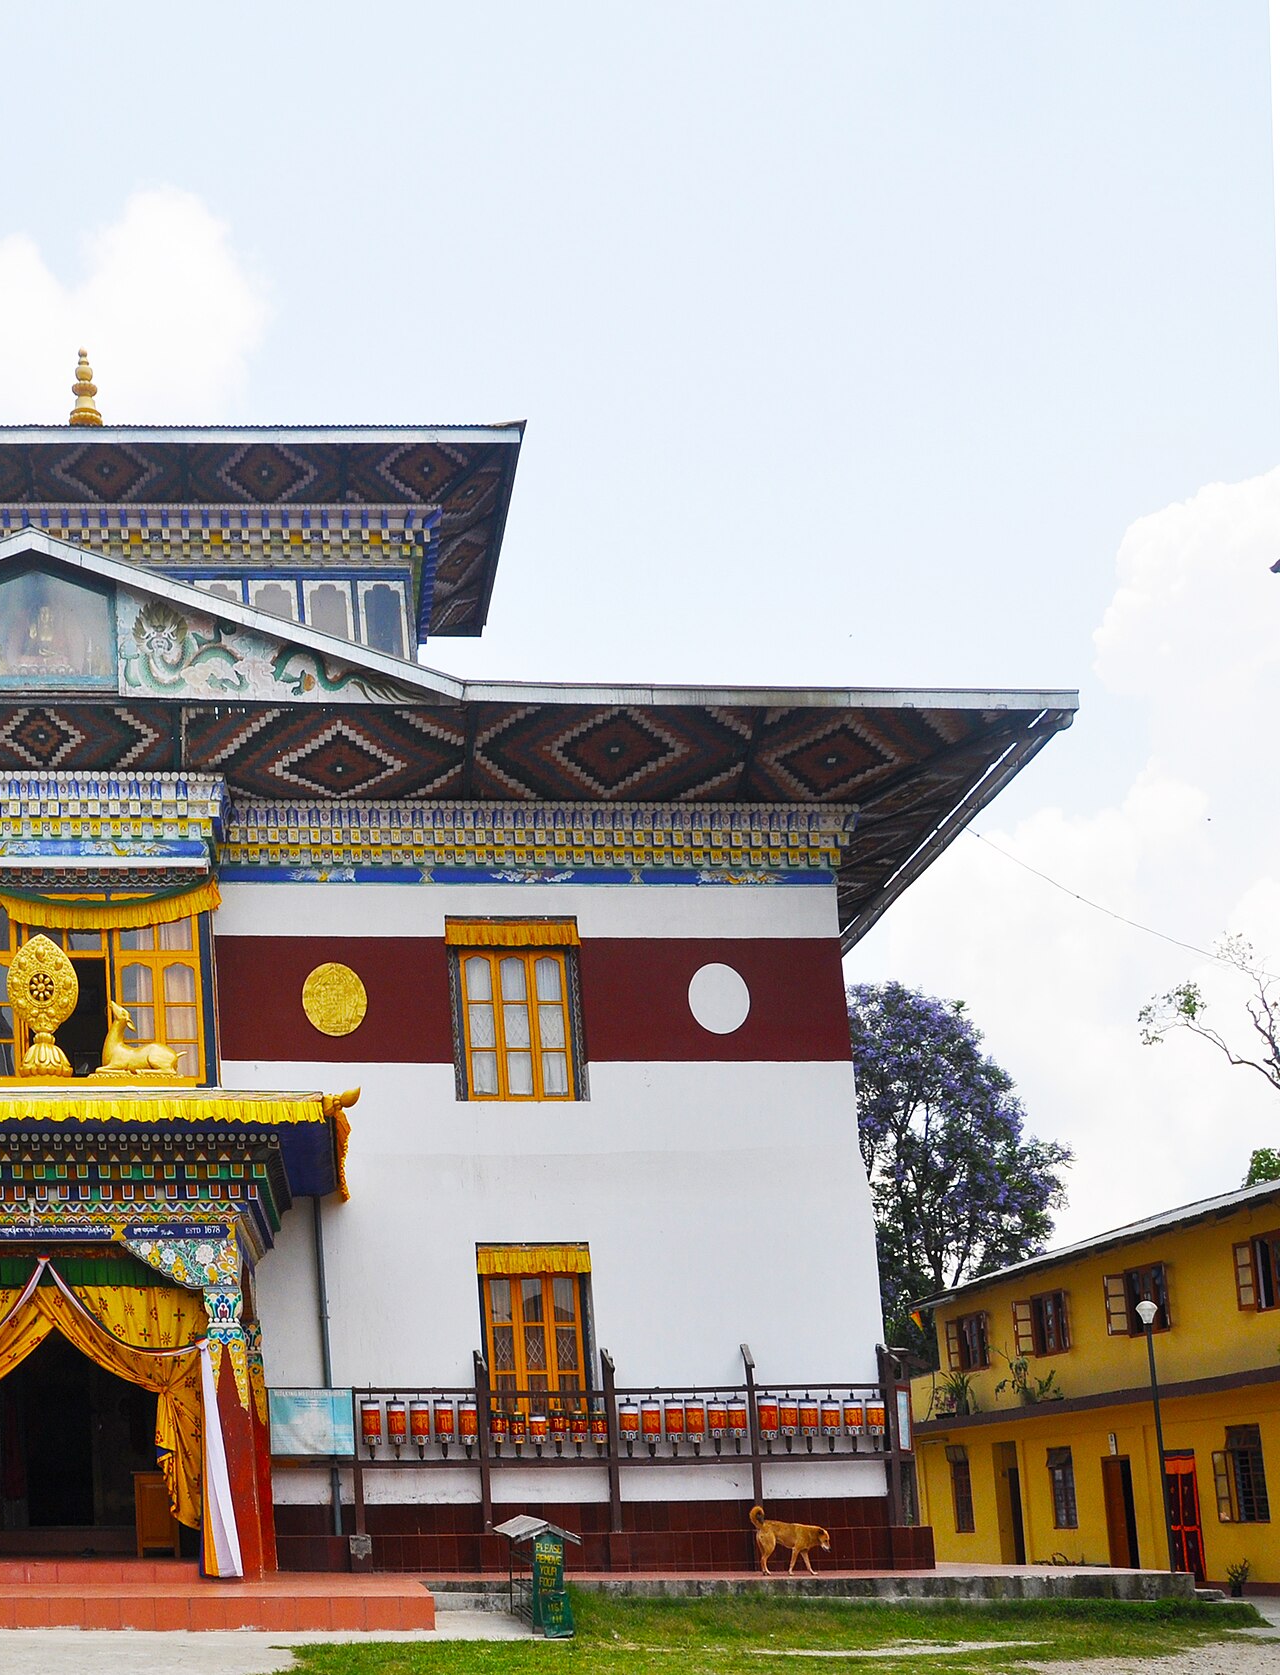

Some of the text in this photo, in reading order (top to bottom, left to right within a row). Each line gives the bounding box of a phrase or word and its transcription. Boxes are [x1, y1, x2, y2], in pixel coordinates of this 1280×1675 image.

[204, 1225, 221, 1234] 1678
[535, 1542, 562, 1554] PLEASE
[535, 1553, 562, 1565] REMOVE
[540, 1566, 557, 1576] YOUR
[539, 1577, 556, 1587] FOOT
[547, 1602, 564, 1613] USE
